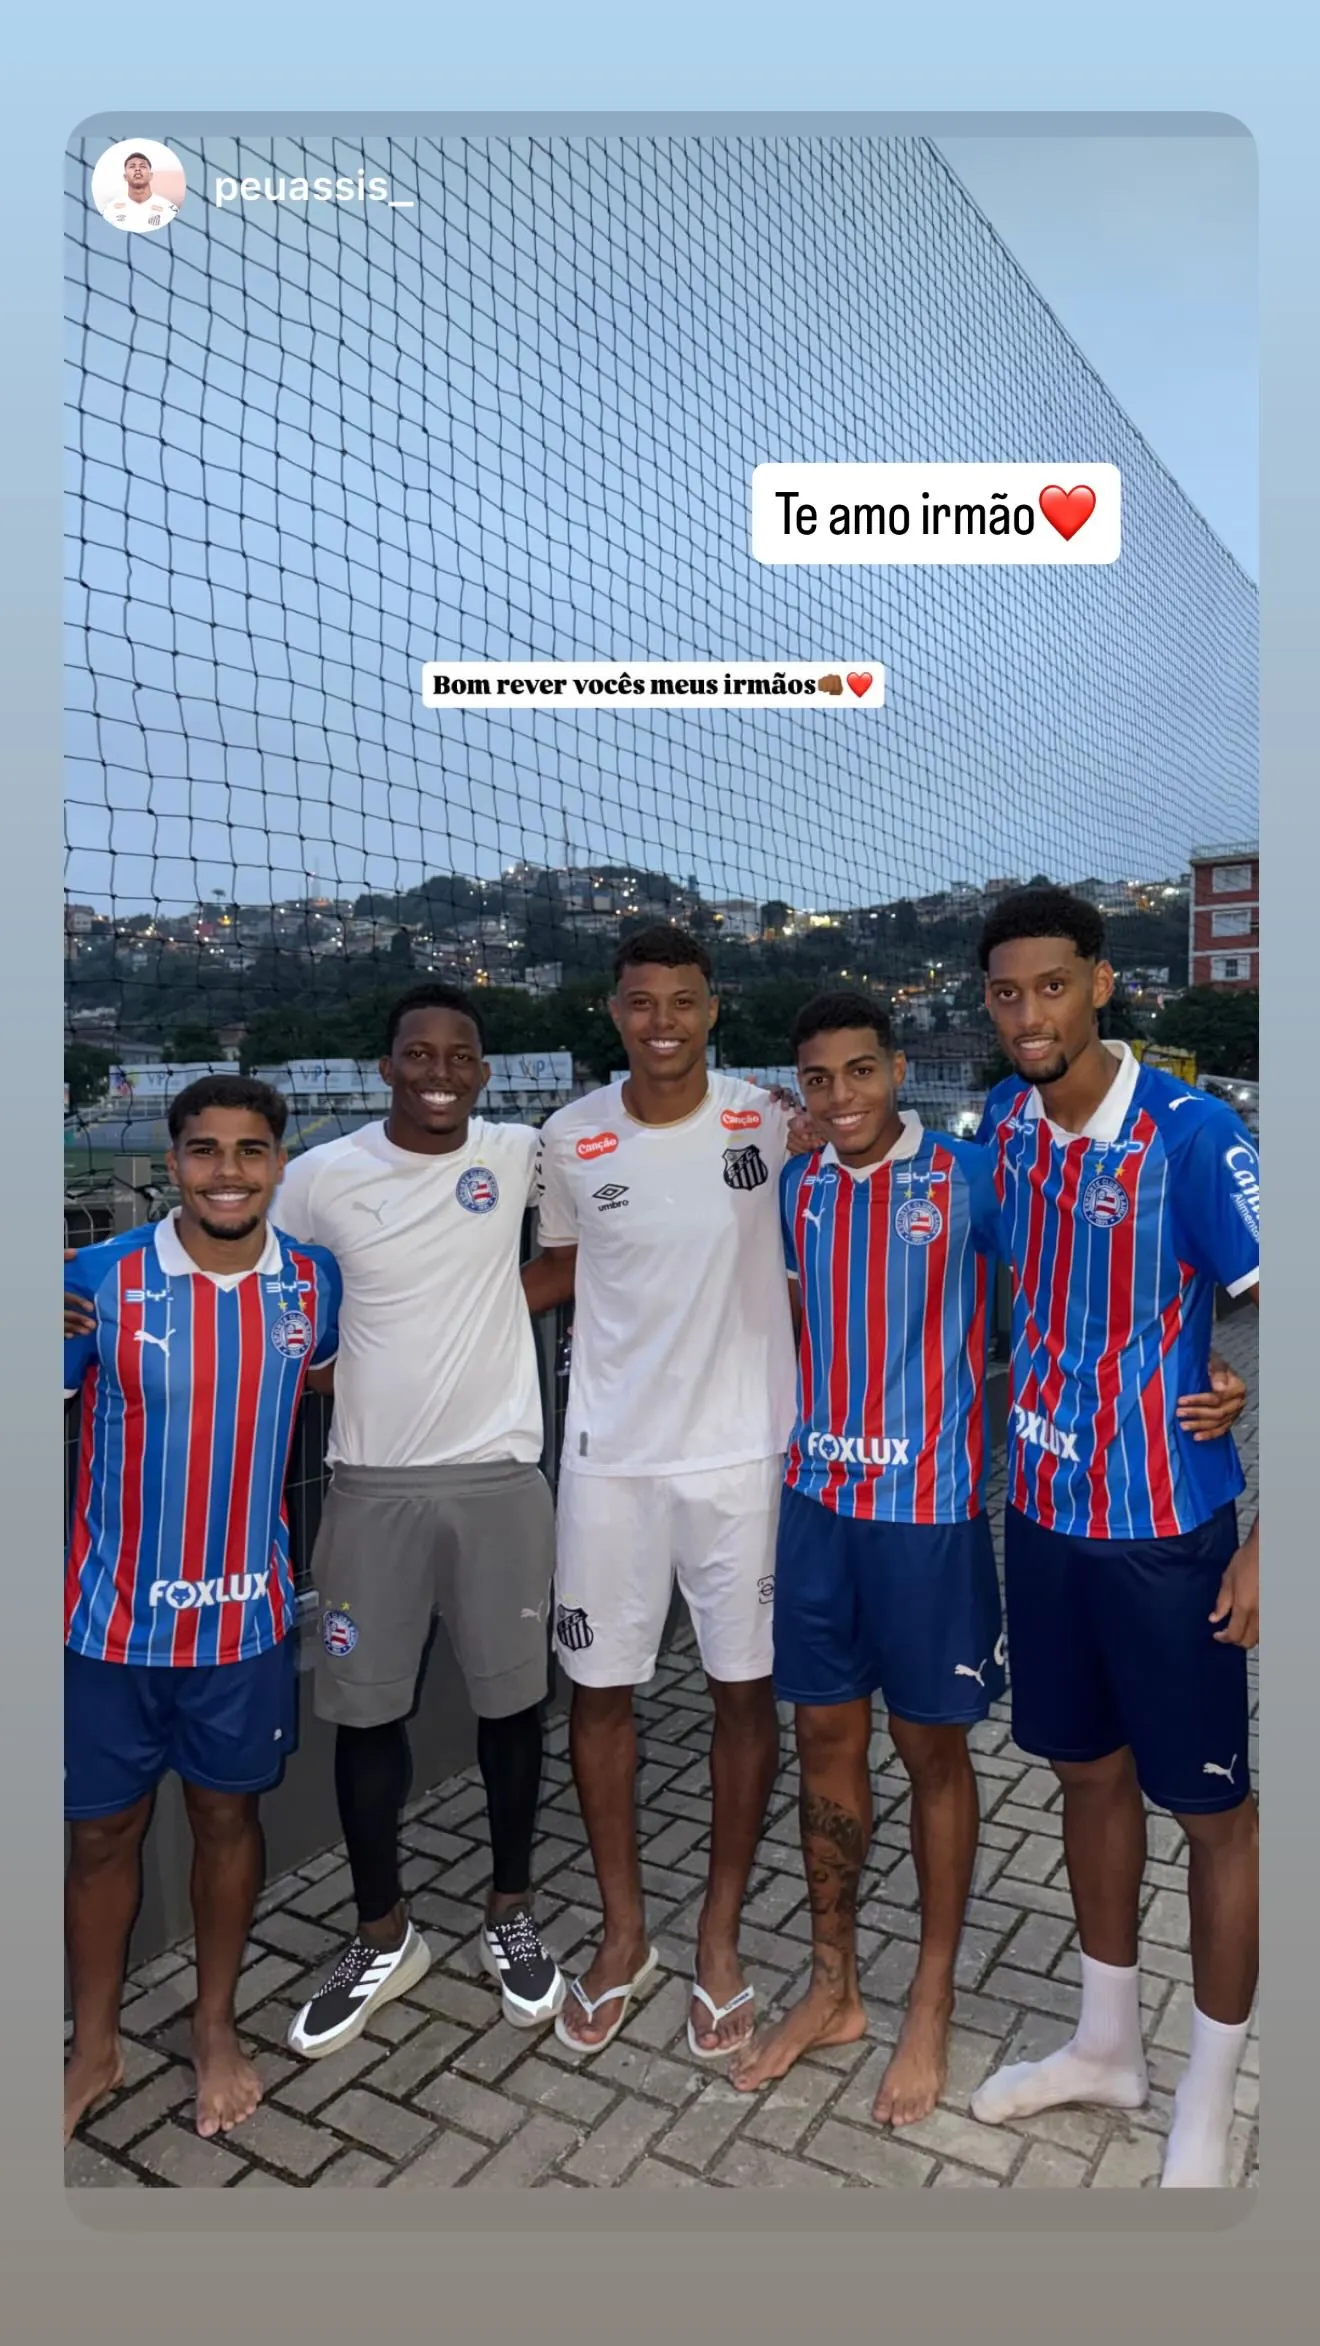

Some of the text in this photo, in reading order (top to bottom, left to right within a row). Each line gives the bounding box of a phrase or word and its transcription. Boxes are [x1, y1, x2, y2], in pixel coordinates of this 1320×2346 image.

[577, 1137, 617, 1154] Canção
[1094, 1141, 1143, 1153] BYD
[896, 1171, 946, 1184] BYD
[598, 1200, 629, 1212] umbro
[265, 1281, 312, 1293] BYD
[125, 1289, 174, 1302] BY
[808, 1431, 910, 1465] FOXLUX
[149, 1570, 270, 1609] FOXLUX
